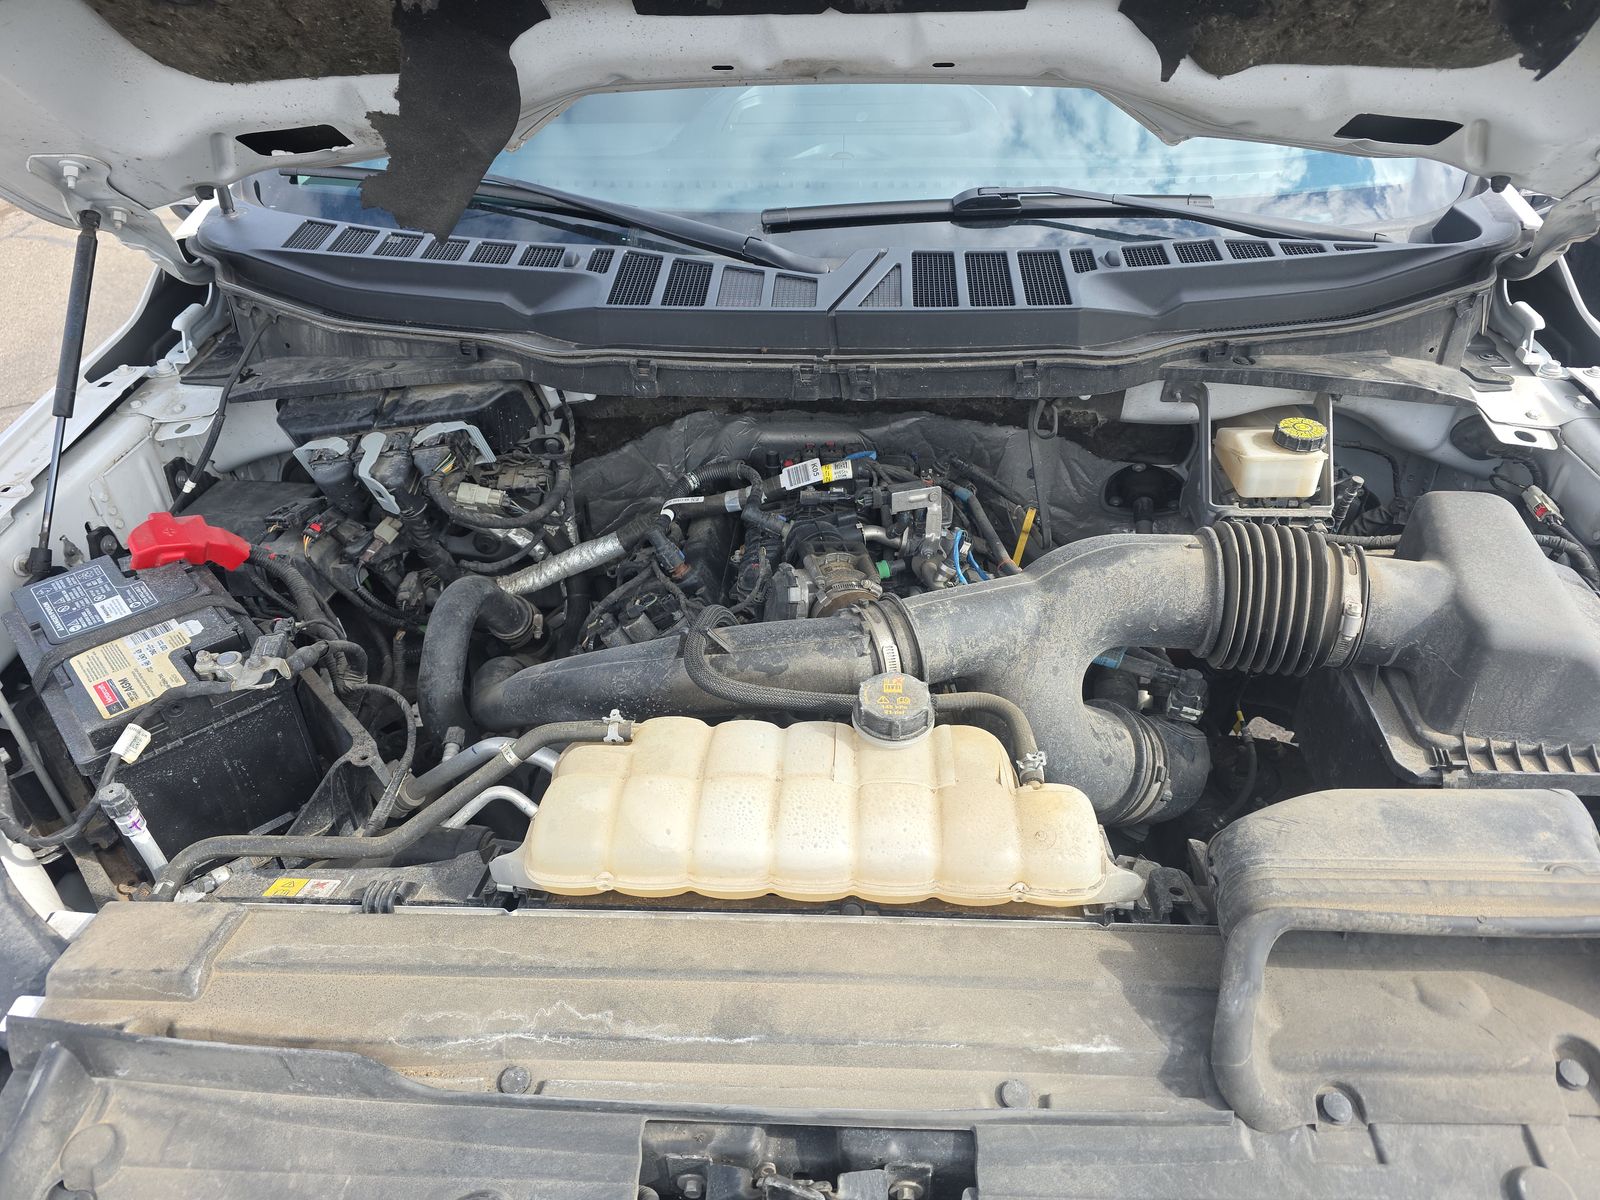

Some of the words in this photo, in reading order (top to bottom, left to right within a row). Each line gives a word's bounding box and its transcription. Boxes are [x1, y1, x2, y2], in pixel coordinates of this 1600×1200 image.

[811, 463, 820, 477] K05
[97, 683, 113, 703] Motorcraft
[117, 676, 134, 693] AGM
